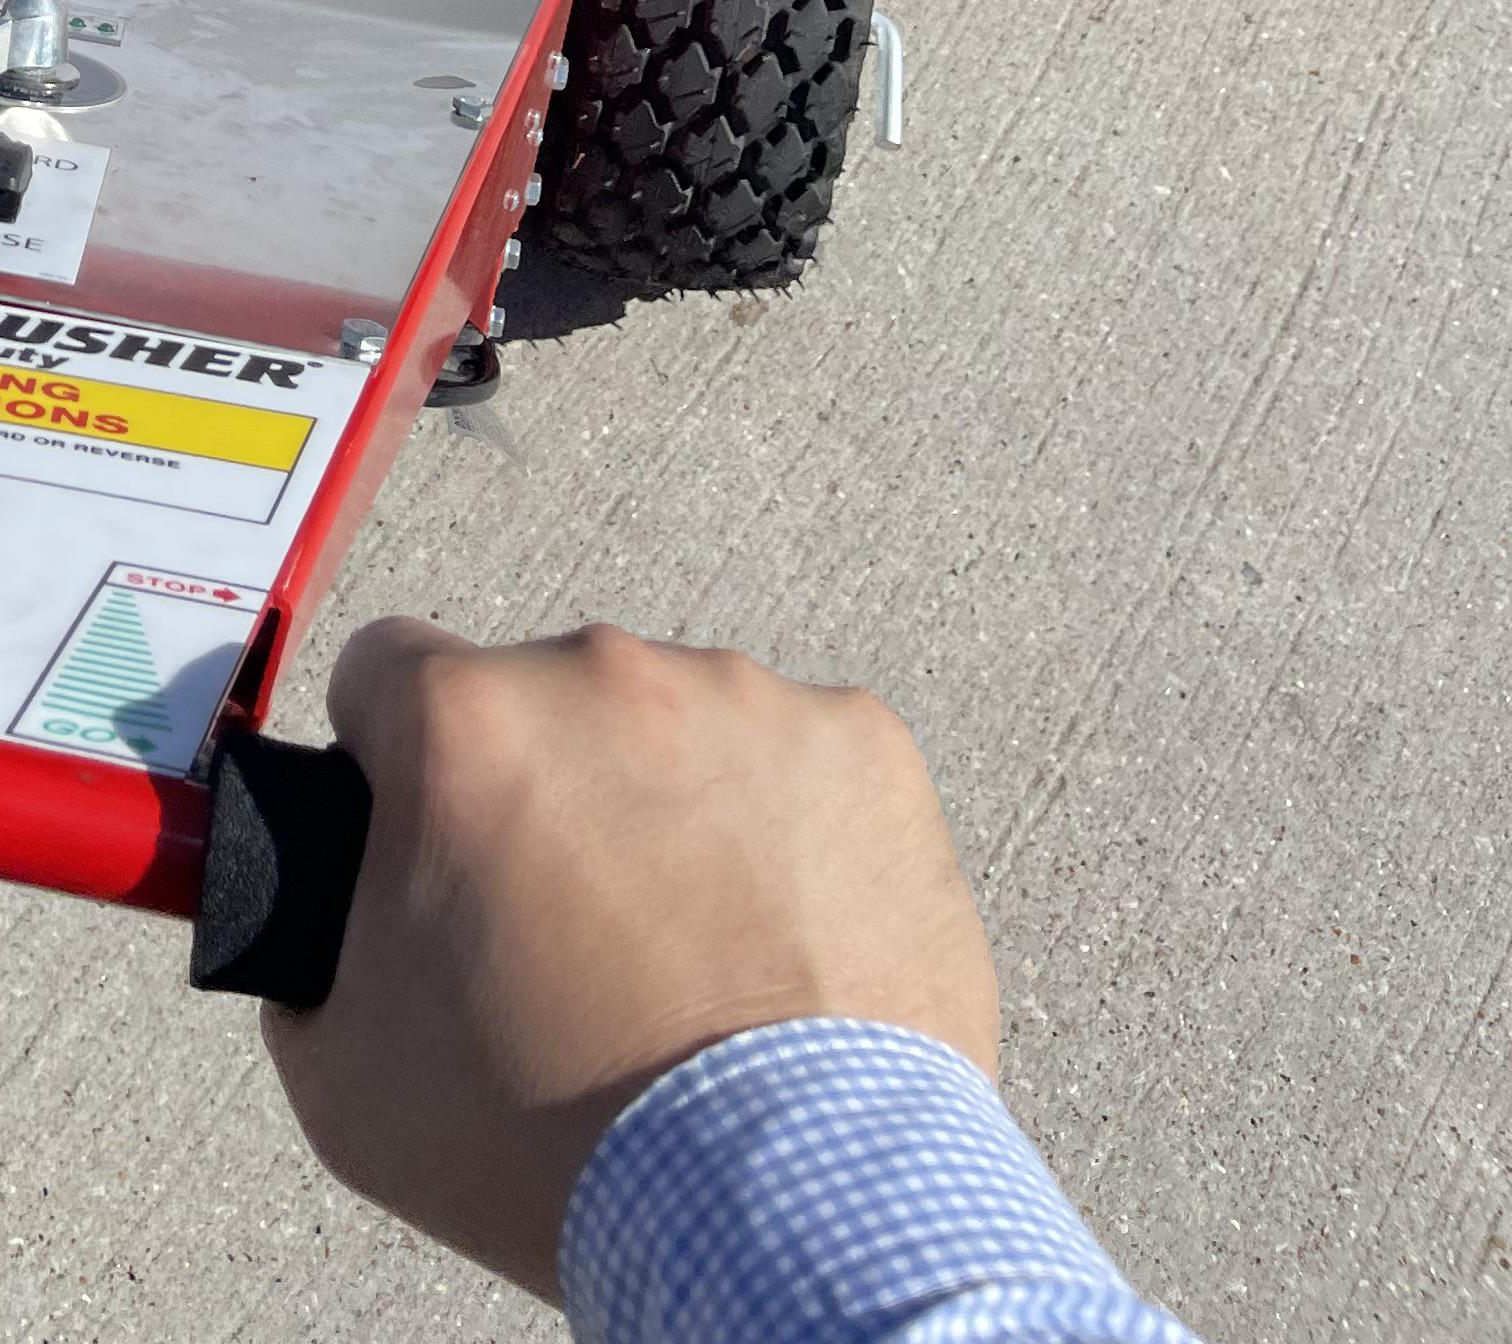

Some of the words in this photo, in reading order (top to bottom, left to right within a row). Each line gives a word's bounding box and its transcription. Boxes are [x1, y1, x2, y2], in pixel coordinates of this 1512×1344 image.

[33, 435, 67, 450] OR
[73, 442, 181, 470] REVERSE
[125, 571, 207, 595] STOP
[41, 717, 118, 744] GO
